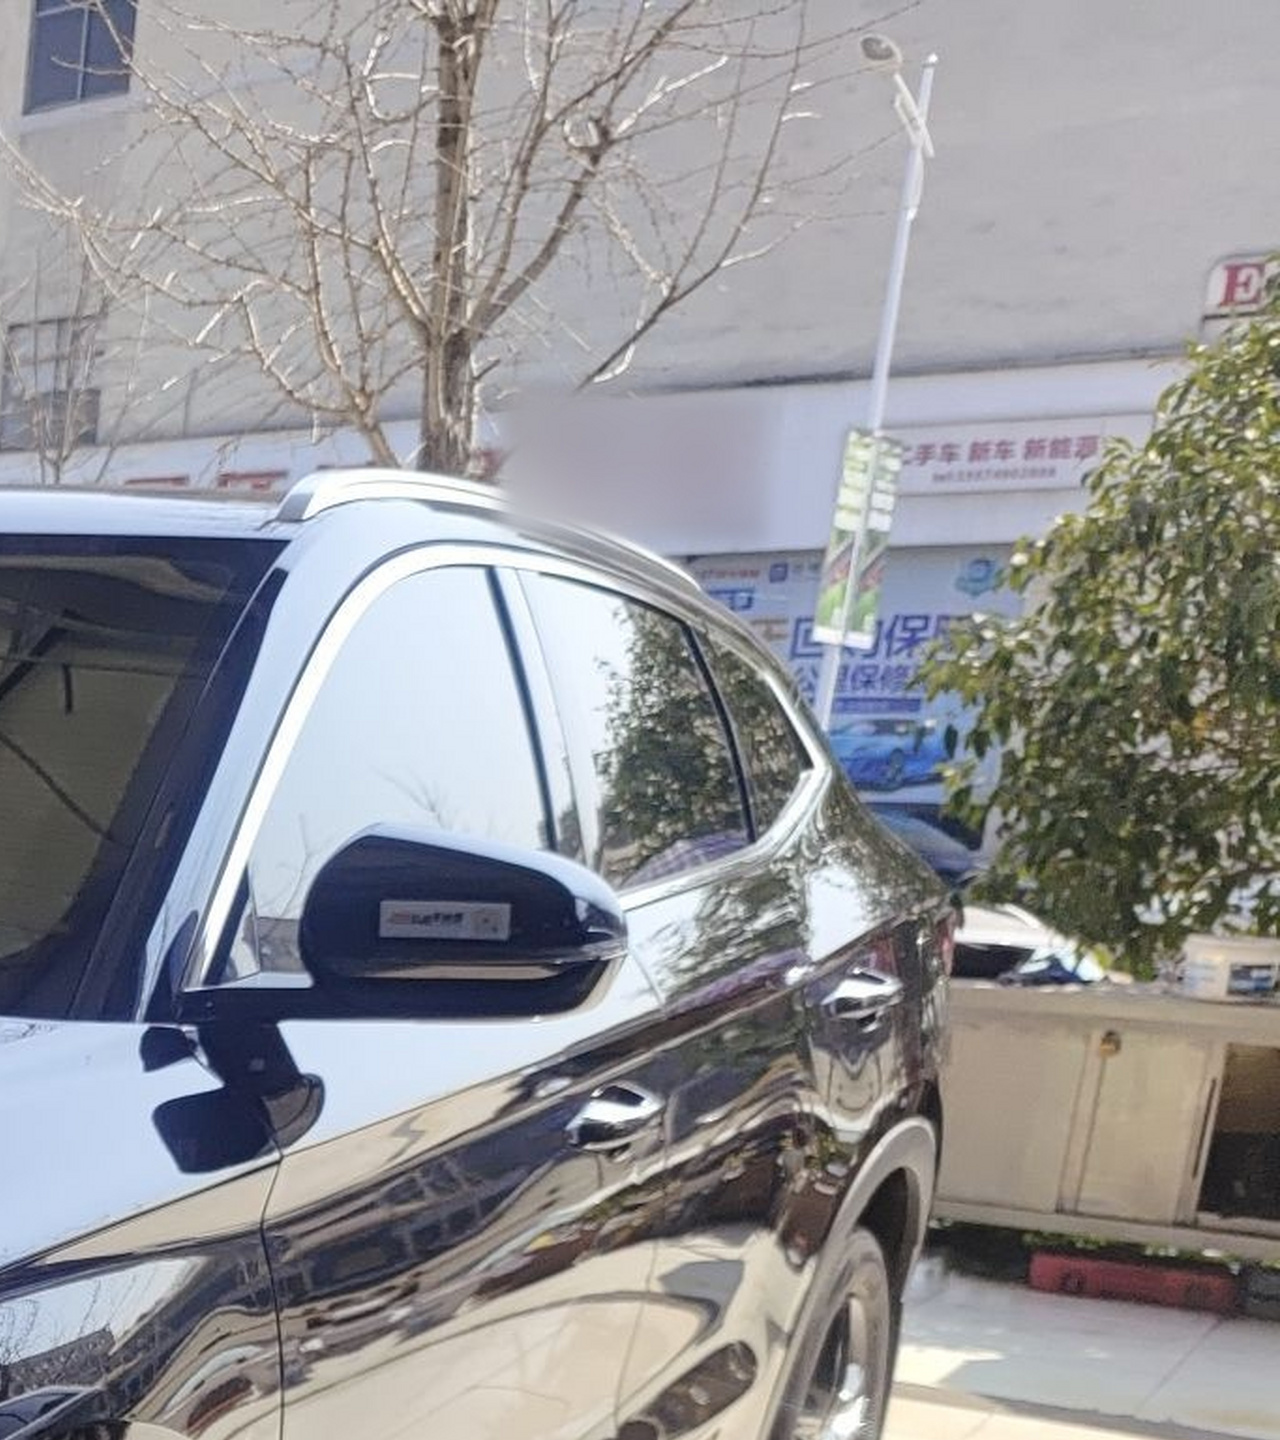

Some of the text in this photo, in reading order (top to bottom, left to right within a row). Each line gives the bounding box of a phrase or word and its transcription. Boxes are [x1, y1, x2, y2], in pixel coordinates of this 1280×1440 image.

[969, 440, 1017, 463] 新车
[1023, 434, 1100, 464] 新能源
